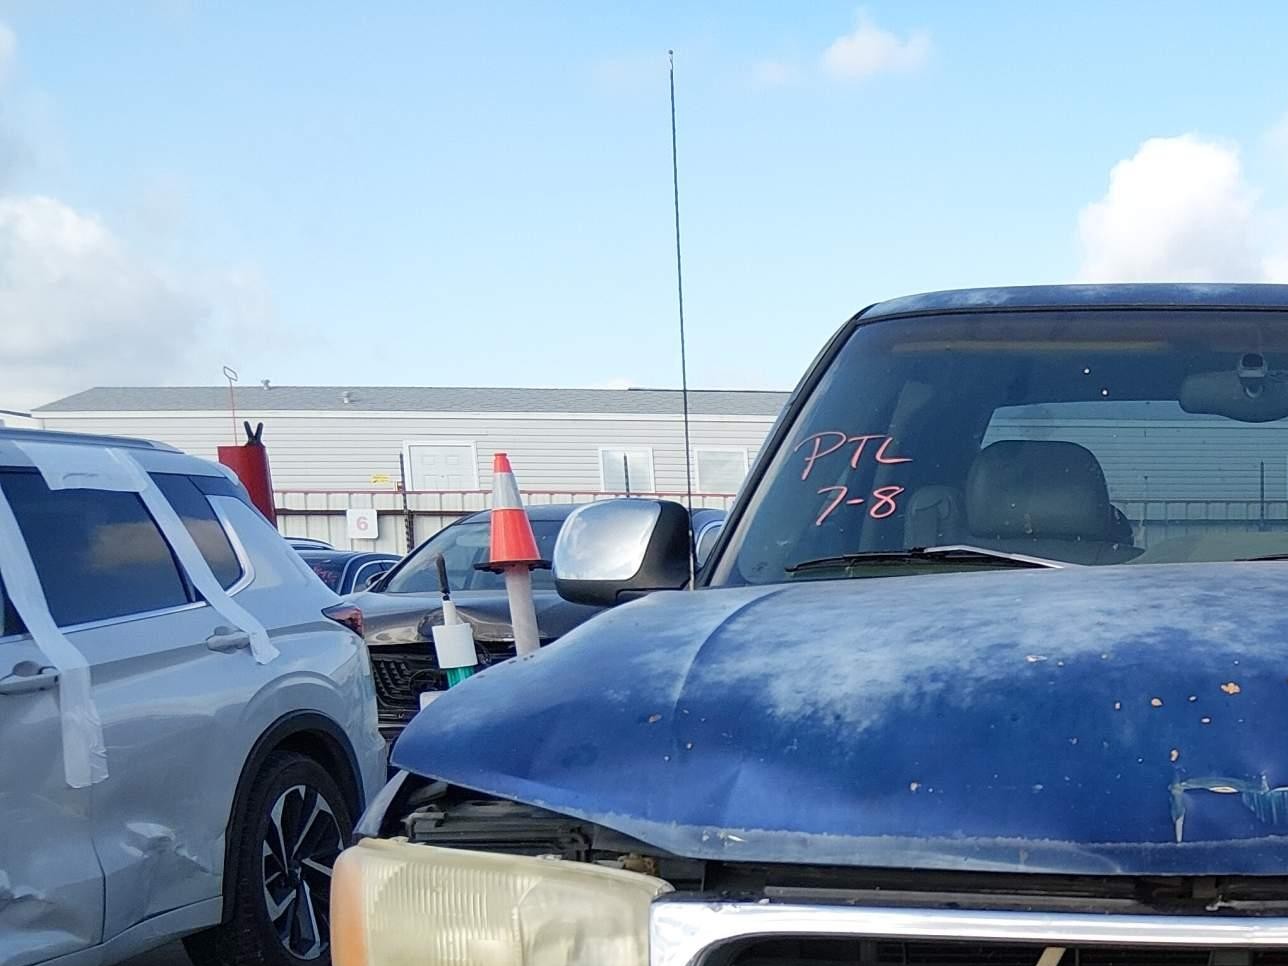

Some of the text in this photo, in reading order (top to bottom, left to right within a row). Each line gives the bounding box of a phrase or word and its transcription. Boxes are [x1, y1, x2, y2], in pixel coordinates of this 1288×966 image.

[794, 431, 913, 481] PTL
[356, 516, 369, 531] 6
[816, 486, 905, 527] 7-8
